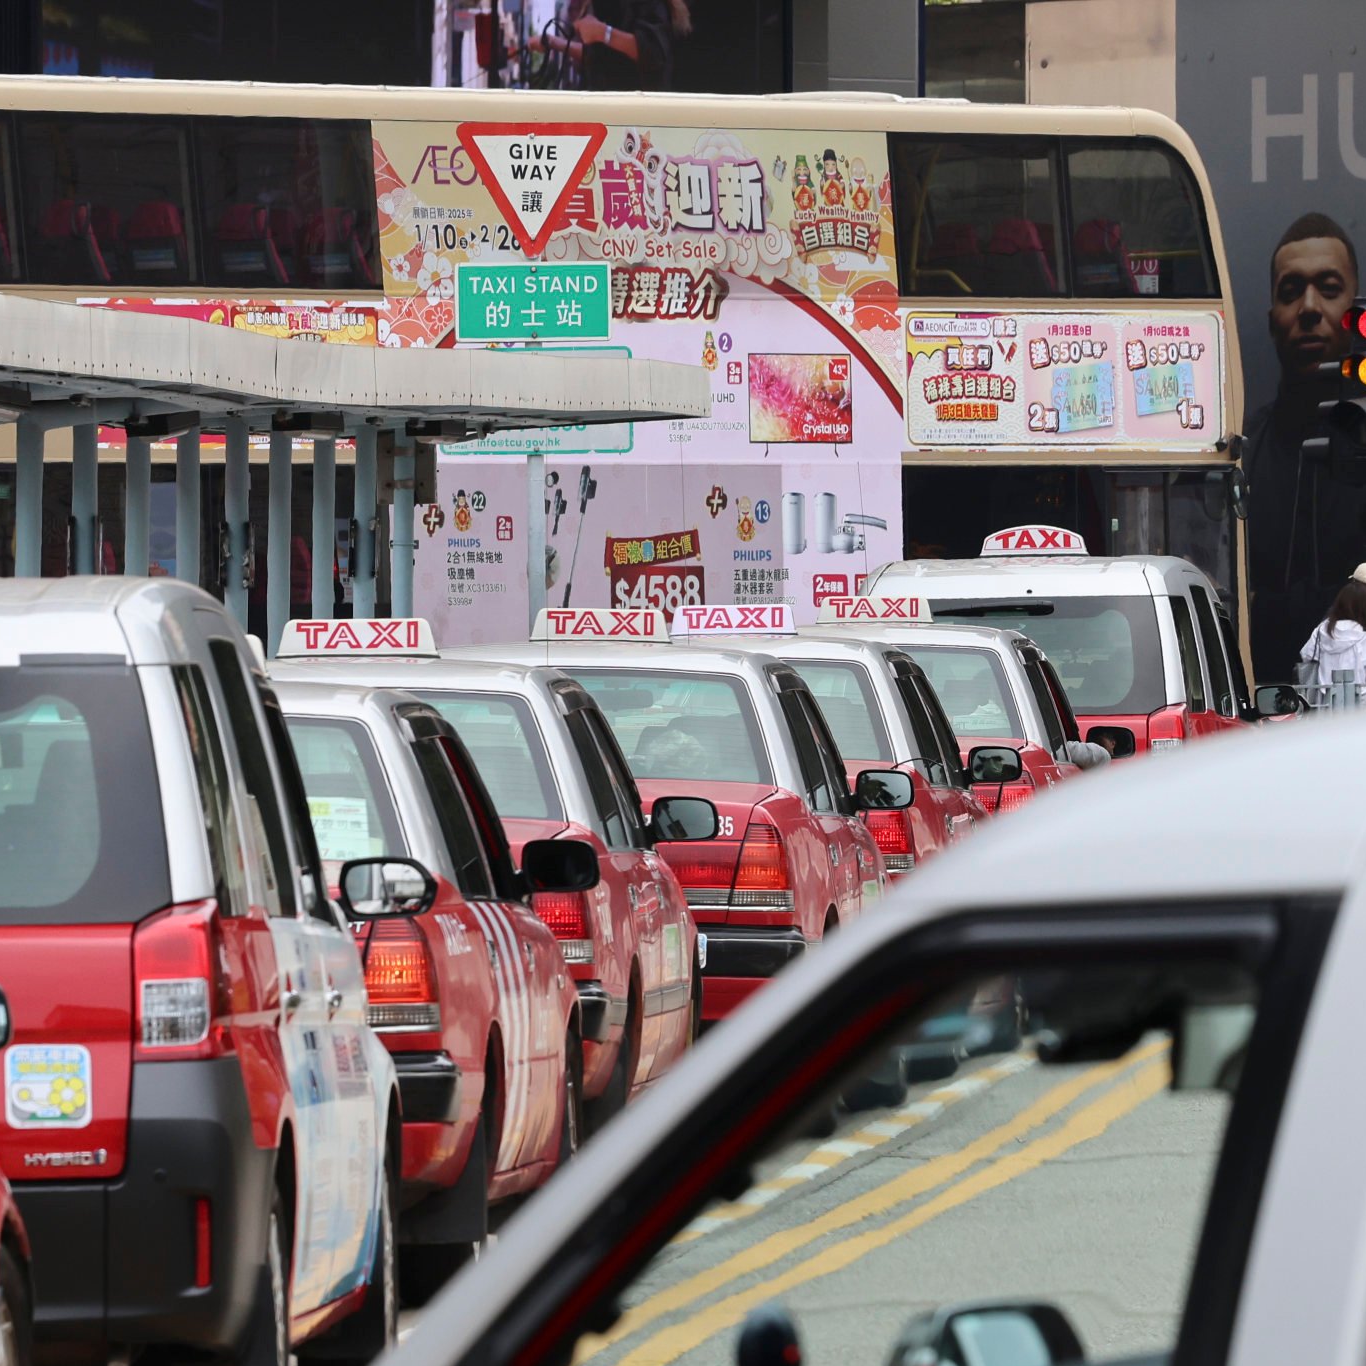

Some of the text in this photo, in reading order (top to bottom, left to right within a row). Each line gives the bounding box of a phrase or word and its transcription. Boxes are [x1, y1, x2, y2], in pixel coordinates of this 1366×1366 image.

[509, 143, 558, 161] GIVE
[511, 164, 556, 181] WAY
[521, 190, 543, 213] 讓
[795, 205, 880, 223] Lucky Wealthy Healthy
[801, 221, 870, 251] 自選組合
[602, 238, 717, 259] CNY Set Sale
[469, 275, 598, 294] TAXI STAND
[485, 299, 583, 328] 的士站
[1047, 324, 1092, 337] 1月3日至9日
[721, 335, 729, 351] 2
[717, 393, 736, 403] UHD
[802, 424, 849, 435] Crystal UHD
[477, 432, 561, 448] info@tcu.gov.hk
[471, 493, 485, 510] 22
[756, 503, 770, 521] 13
[447, 538, 481, 548] PHILIPS
[995, 529, 1072, 549] TAXI
[447, 551, 503, 564] 2合1無線拖地
[733, 549, 772, 562] PHILIPS
[447, 567, 475, 580] 吸塵機
[615, 574, 701, 609] $4588
[829, 598, 920, 618] TAXI
[547, 610, 656, 636] TAXI
[683, 607, 784, 630] TAXI
[295, 620, 420, 648] TAXI
